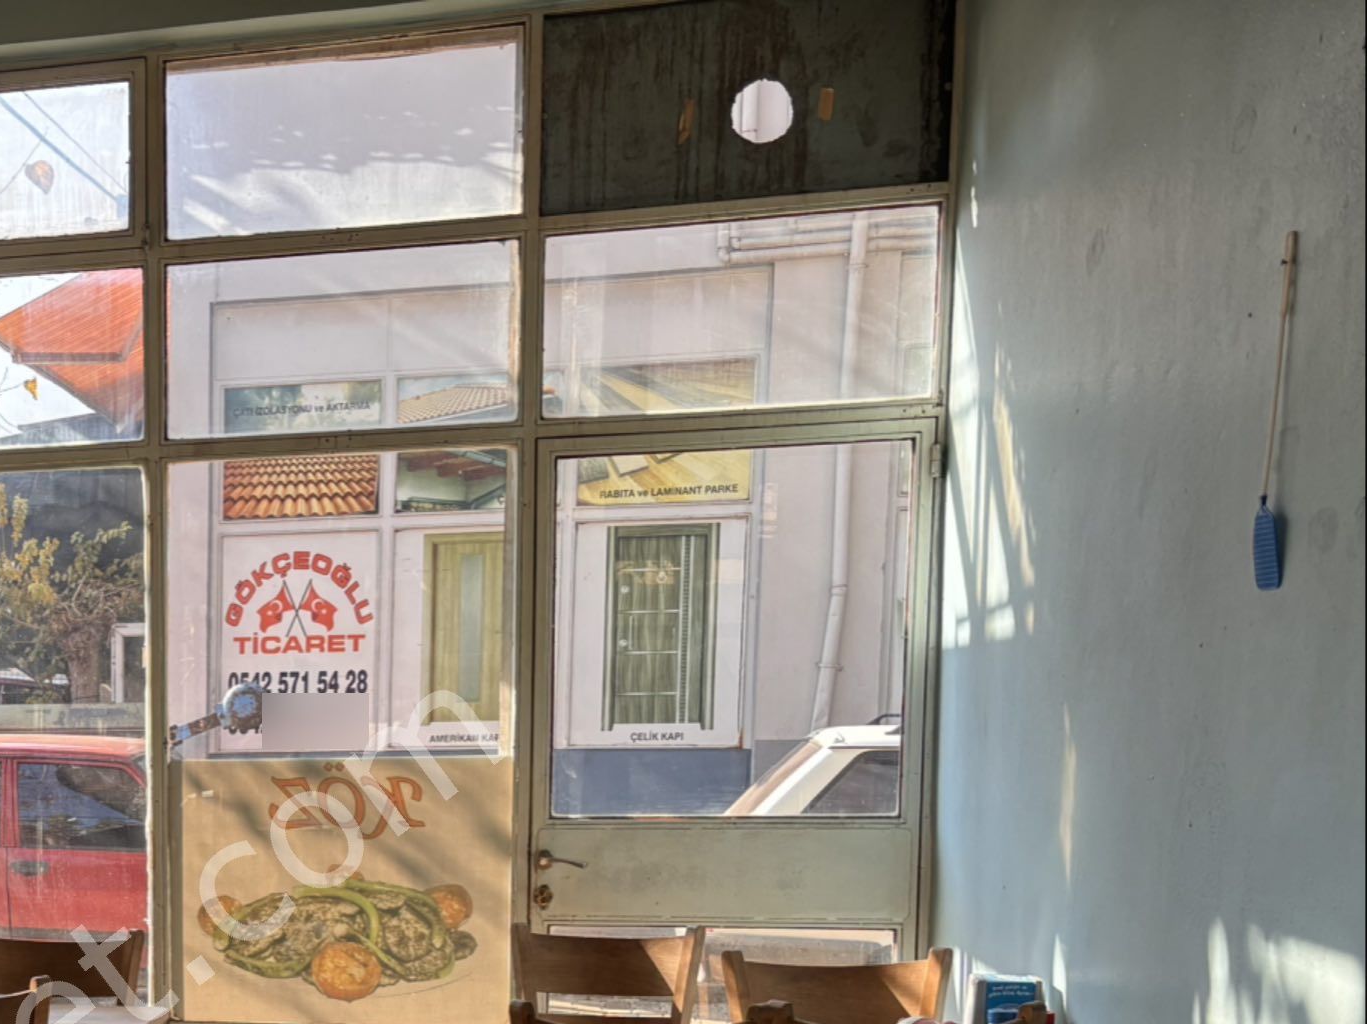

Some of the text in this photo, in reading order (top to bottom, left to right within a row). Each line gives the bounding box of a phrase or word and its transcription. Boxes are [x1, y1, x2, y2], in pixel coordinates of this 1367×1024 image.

[326, 401, 371, 412] AKTARMA
[600, 488, 635, 499] RABITA
[638, 489, 649, 497] ve
[704, 484, 739, 495] PARKE
[225, 551, 374, 627] GÖKÇEOĞLU
[233, 632, 366, 655] TİCARET
[278, 671, 309, 694] 571
[316, 670, 339, 694] 54
[345, 669, 369, 694] 28
[630, 731, 684, 743] ÇELİK KAPI
